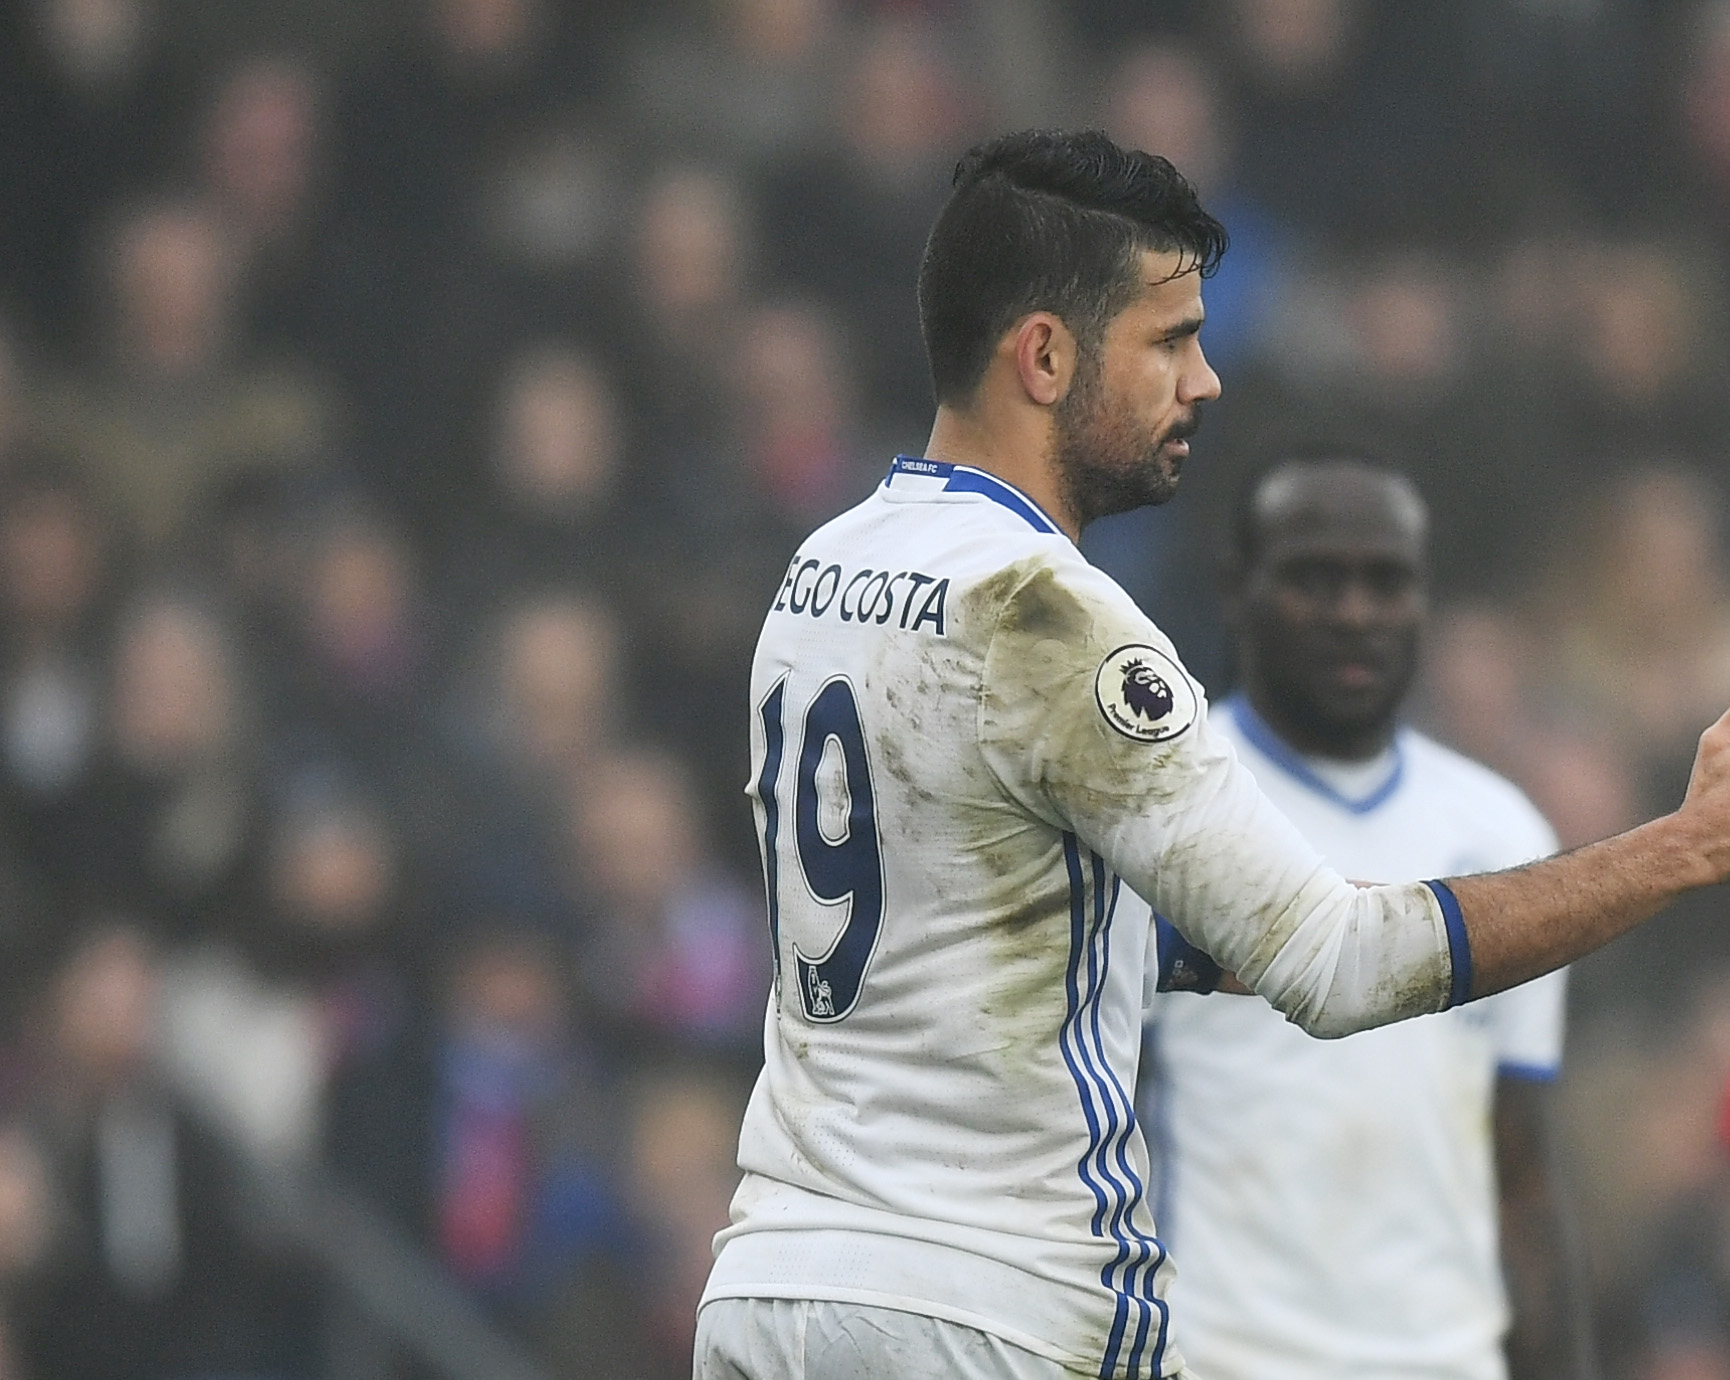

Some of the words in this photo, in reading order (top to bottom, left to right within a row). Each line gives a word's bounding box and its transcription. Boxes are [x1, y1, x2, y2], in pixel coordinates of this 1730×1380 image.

[840, 569, 951, 636] COSTA
[1107, 702, 1135, 730] Premier
[1135, 723, 1170, 739] League
[757, 668, 887, 1024] 19
